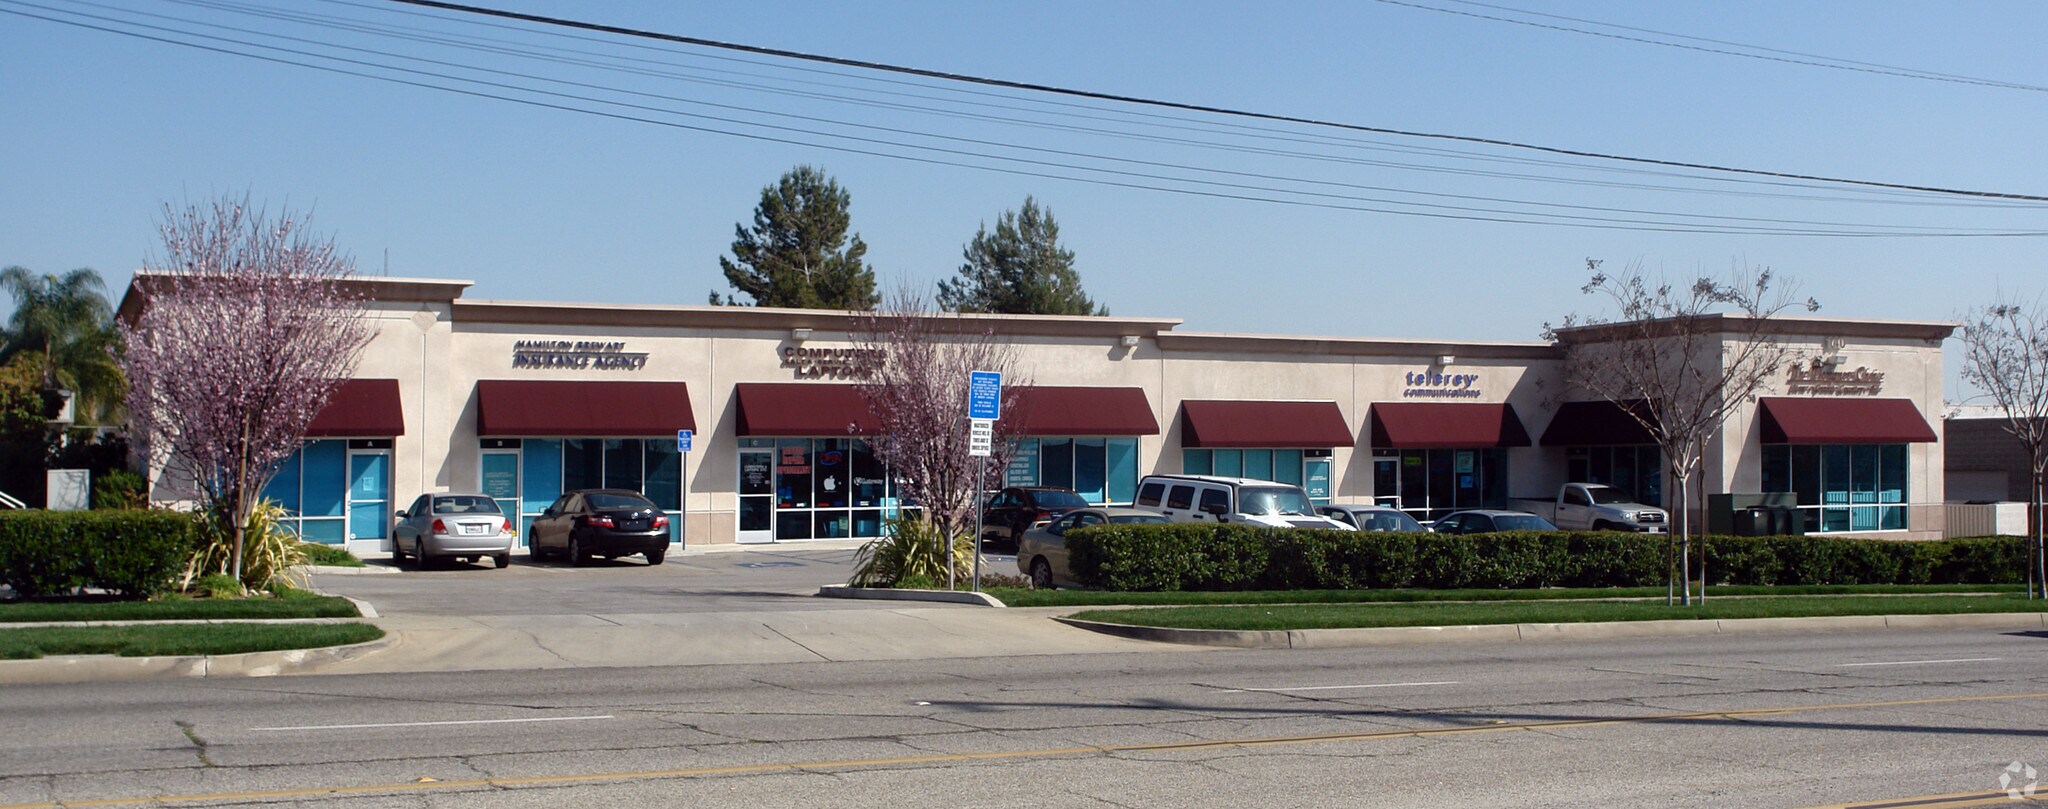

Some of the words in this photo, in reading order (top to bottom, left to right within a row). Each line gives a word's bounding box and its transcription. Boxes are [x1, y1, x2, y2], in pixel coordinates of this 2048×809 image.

[514, 340, 574, 351] HAMILTON
[513, 355, 590, 368] INSURANCE
[592, 356, 649, 370] AGENCY
[1407, 371, 1474, 388] telerey
[1403, 389, 1481, 398] communications
